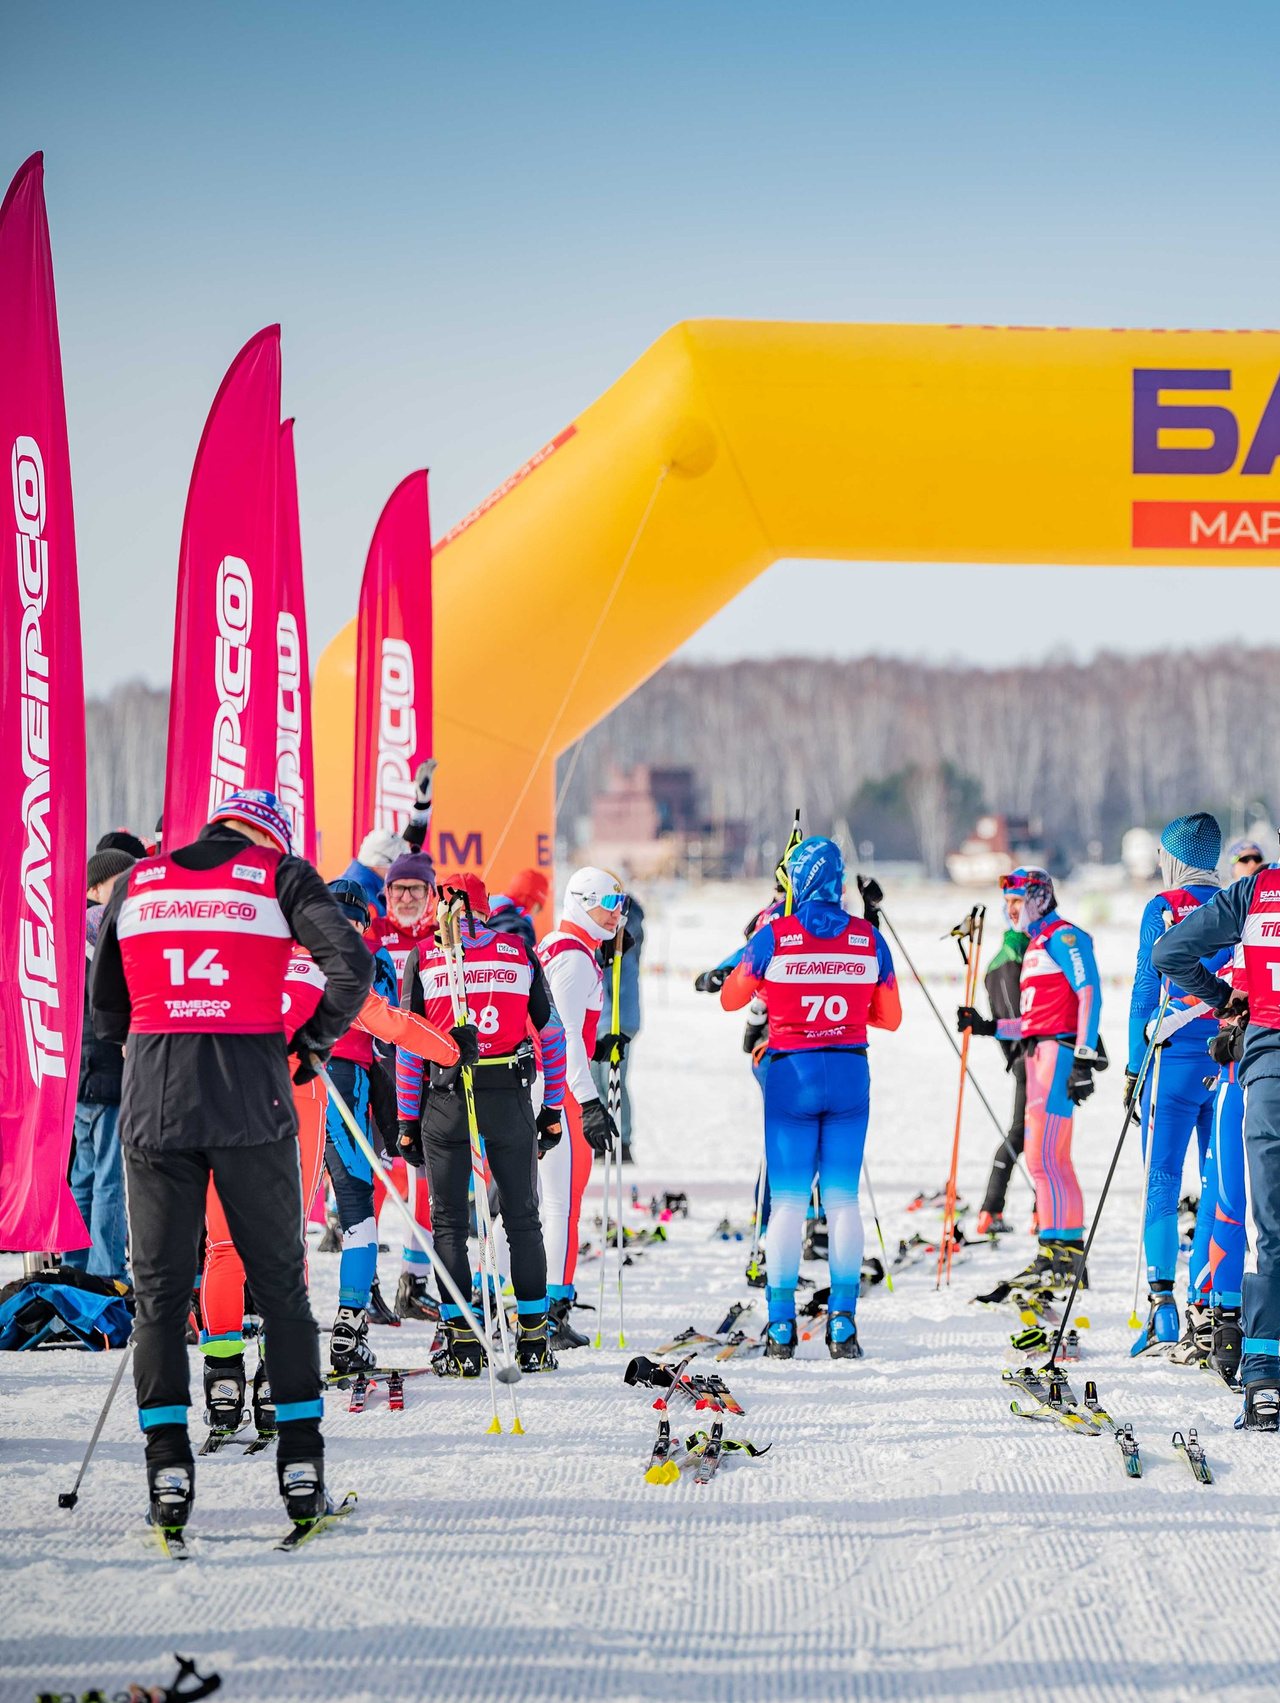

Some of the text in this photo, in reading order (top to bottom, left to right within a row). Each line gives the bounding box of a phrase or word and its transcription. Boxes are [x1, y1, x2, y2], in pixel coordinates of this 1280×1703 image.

[139, 900, 257, 922] ТЕМЕРСО
[163, 948, 230, 986] 14
[784, 961, 866, 976] ТЕМЕРСО
[164, 1000, 232, 1010] ТЕМЕРСО
[169, 1008, 227, 1018] АНГАРА
[800, 995, 848, 1022] 70
